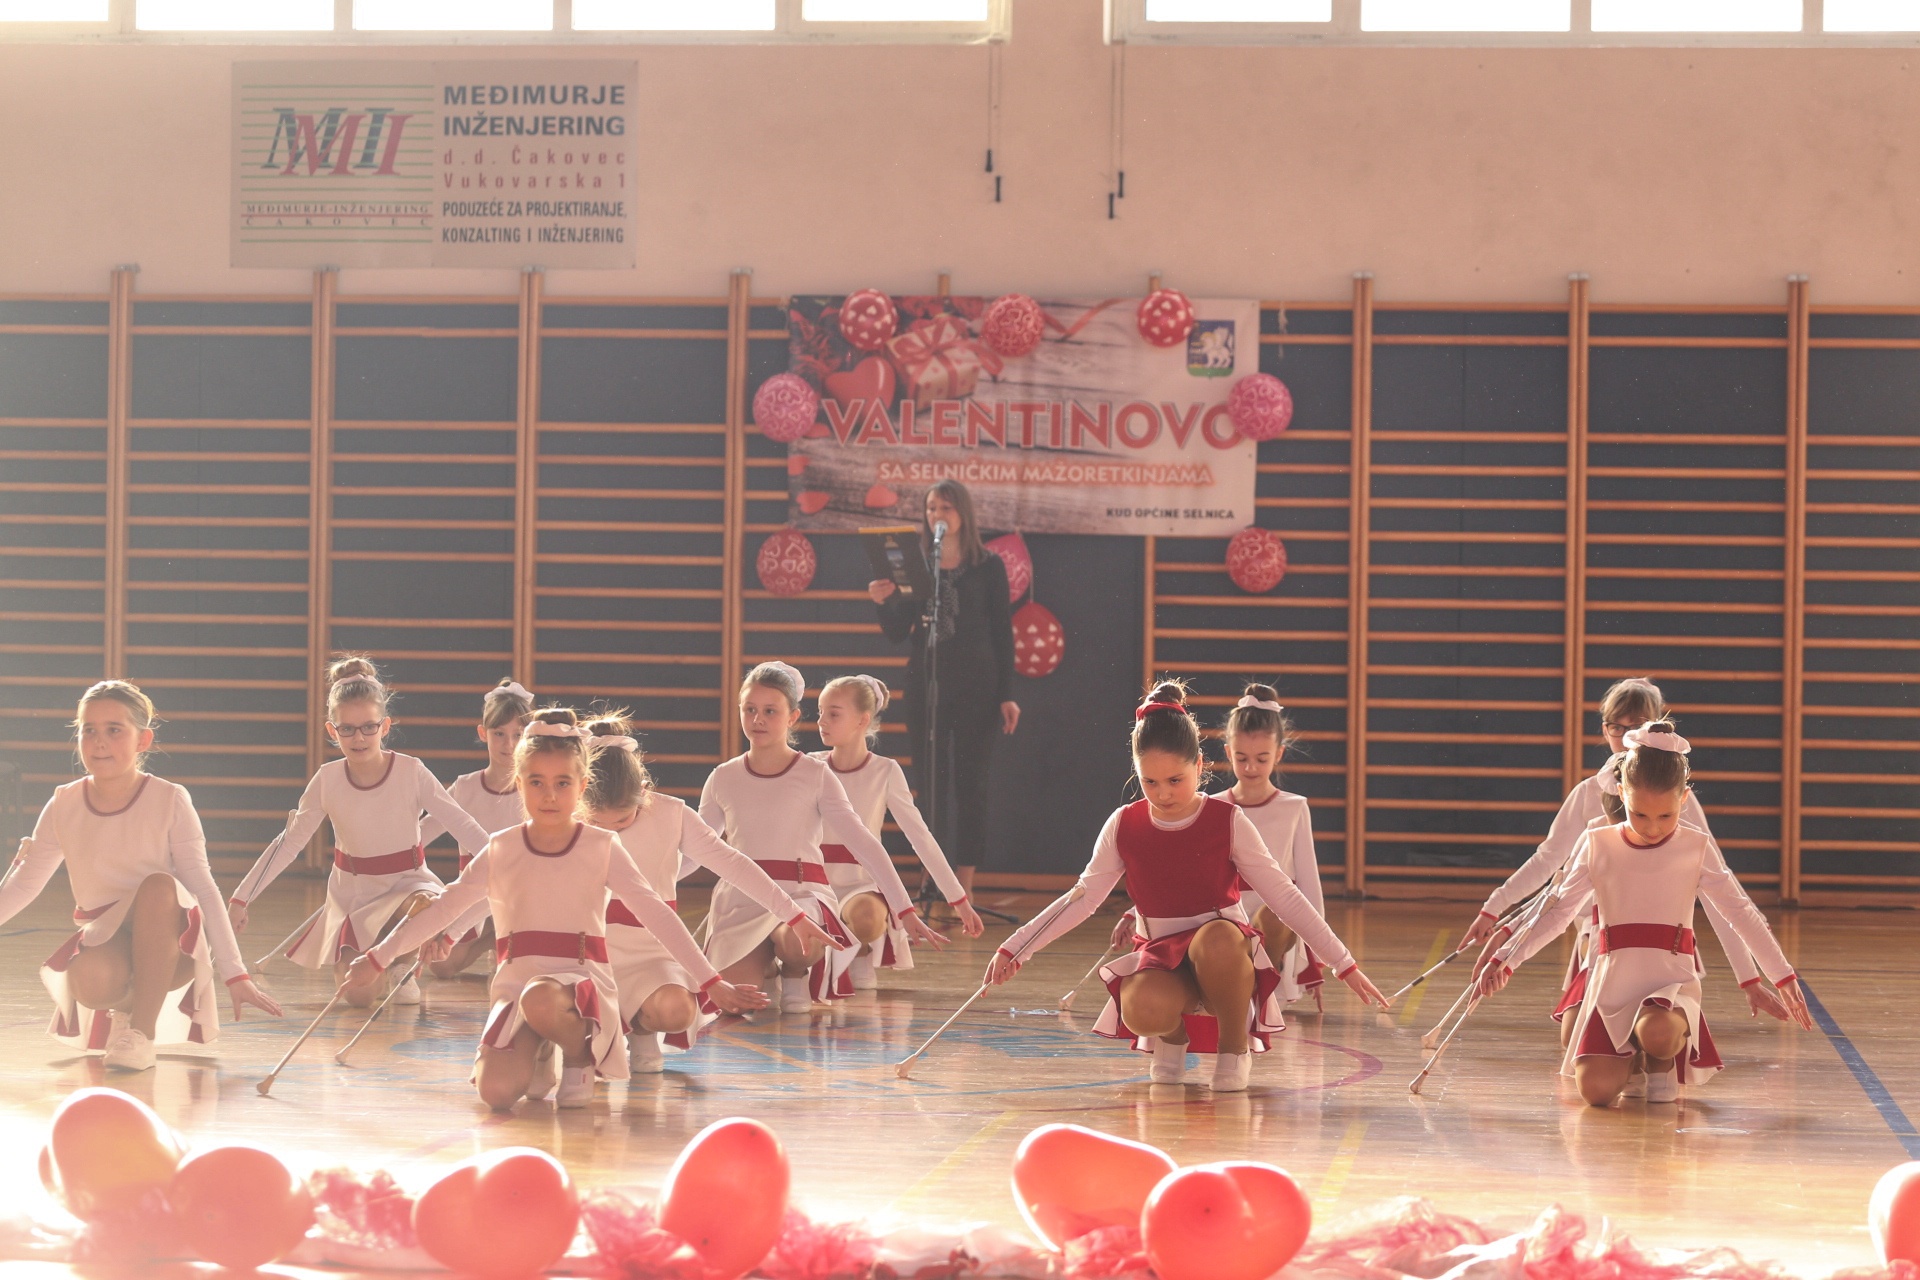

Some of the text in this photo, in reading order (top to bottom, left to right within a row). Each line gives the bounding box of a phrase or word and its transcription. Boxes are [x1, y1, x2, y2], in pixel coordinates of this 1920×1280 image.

[444, 85, 626, 106] MEĐIMURJE
[444, 111, 626, 136] INŽENJERING
[511, 145, 626, 166] Čakovec
[443, 173, 625, 189] Vukovarska 1
[442, 197, 628, 219] PODUZEĆE ZA PROJEKTIRANJE,
[442, 224, 624, 243] KONZALTING I INŽENJERING
[822, 399, 1243, 449] VALENTINOVO
[879, 460, 1213, 483] SA SELNIČKIM MAŽORETKINJAMA
[1106, 508, 1132, 517] KUD
[1183, 509, 1235, 519] SELNICA
